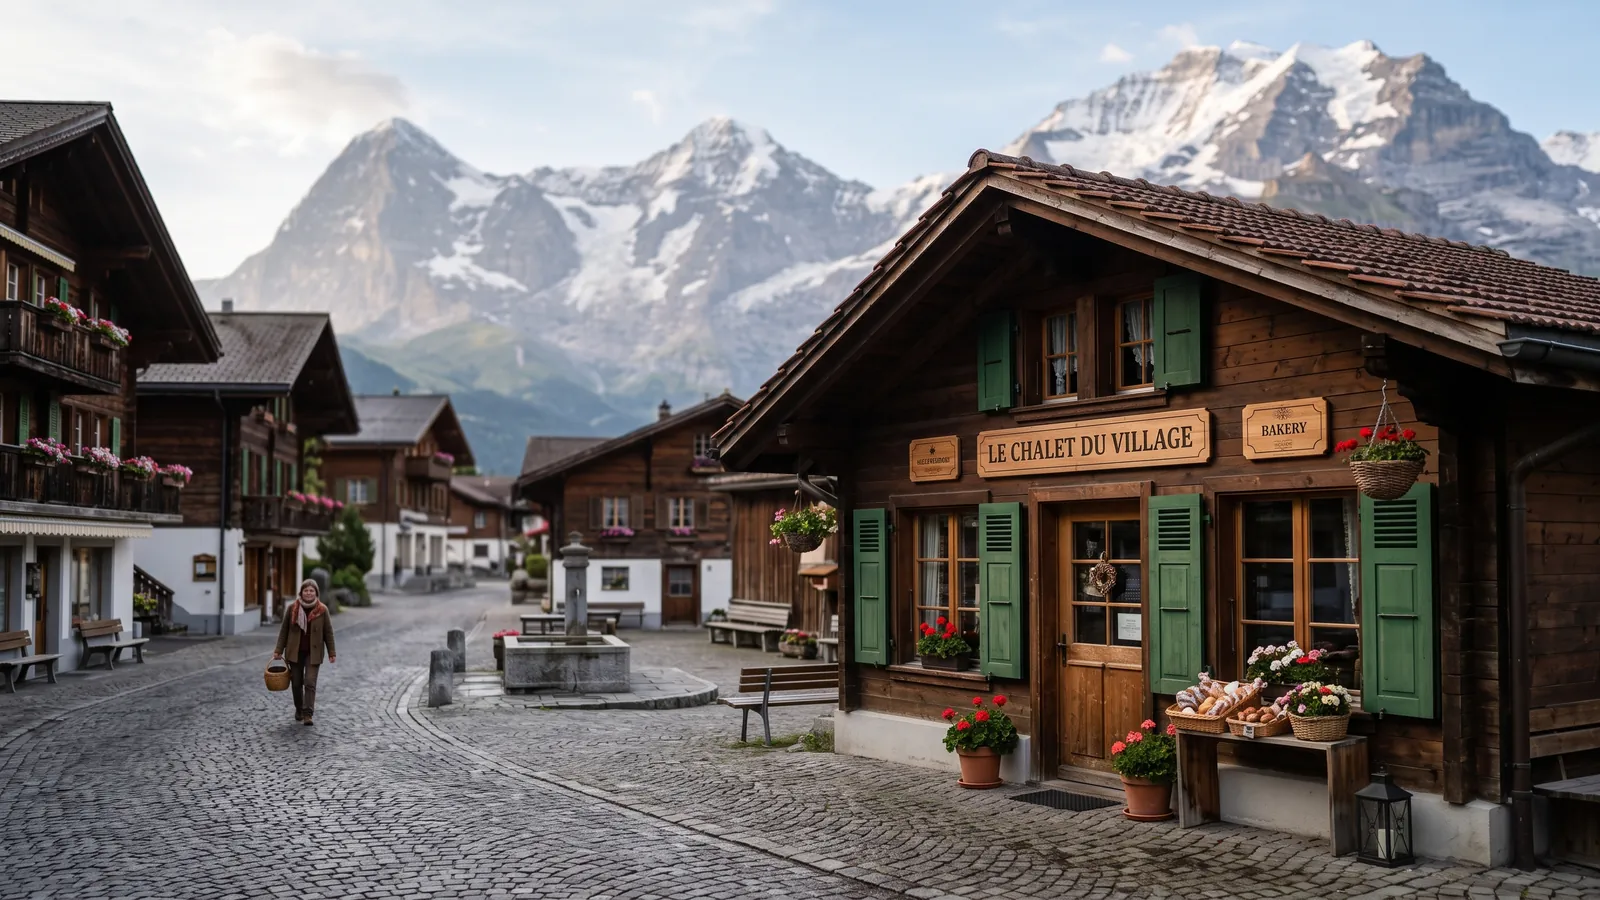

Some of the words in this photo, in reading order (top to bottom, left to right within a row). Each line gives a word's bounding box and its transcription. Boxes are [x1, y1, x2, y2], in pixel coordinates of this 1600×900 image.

[1261, 422, 1307, 436] BAKERY
[988, 444, 1007, 463] LE
[1011, 437, 1076, 462] CHALET
[1080, 434, 1107, 457] DU
[1111, 426, 1193, 454] VILLAGE
